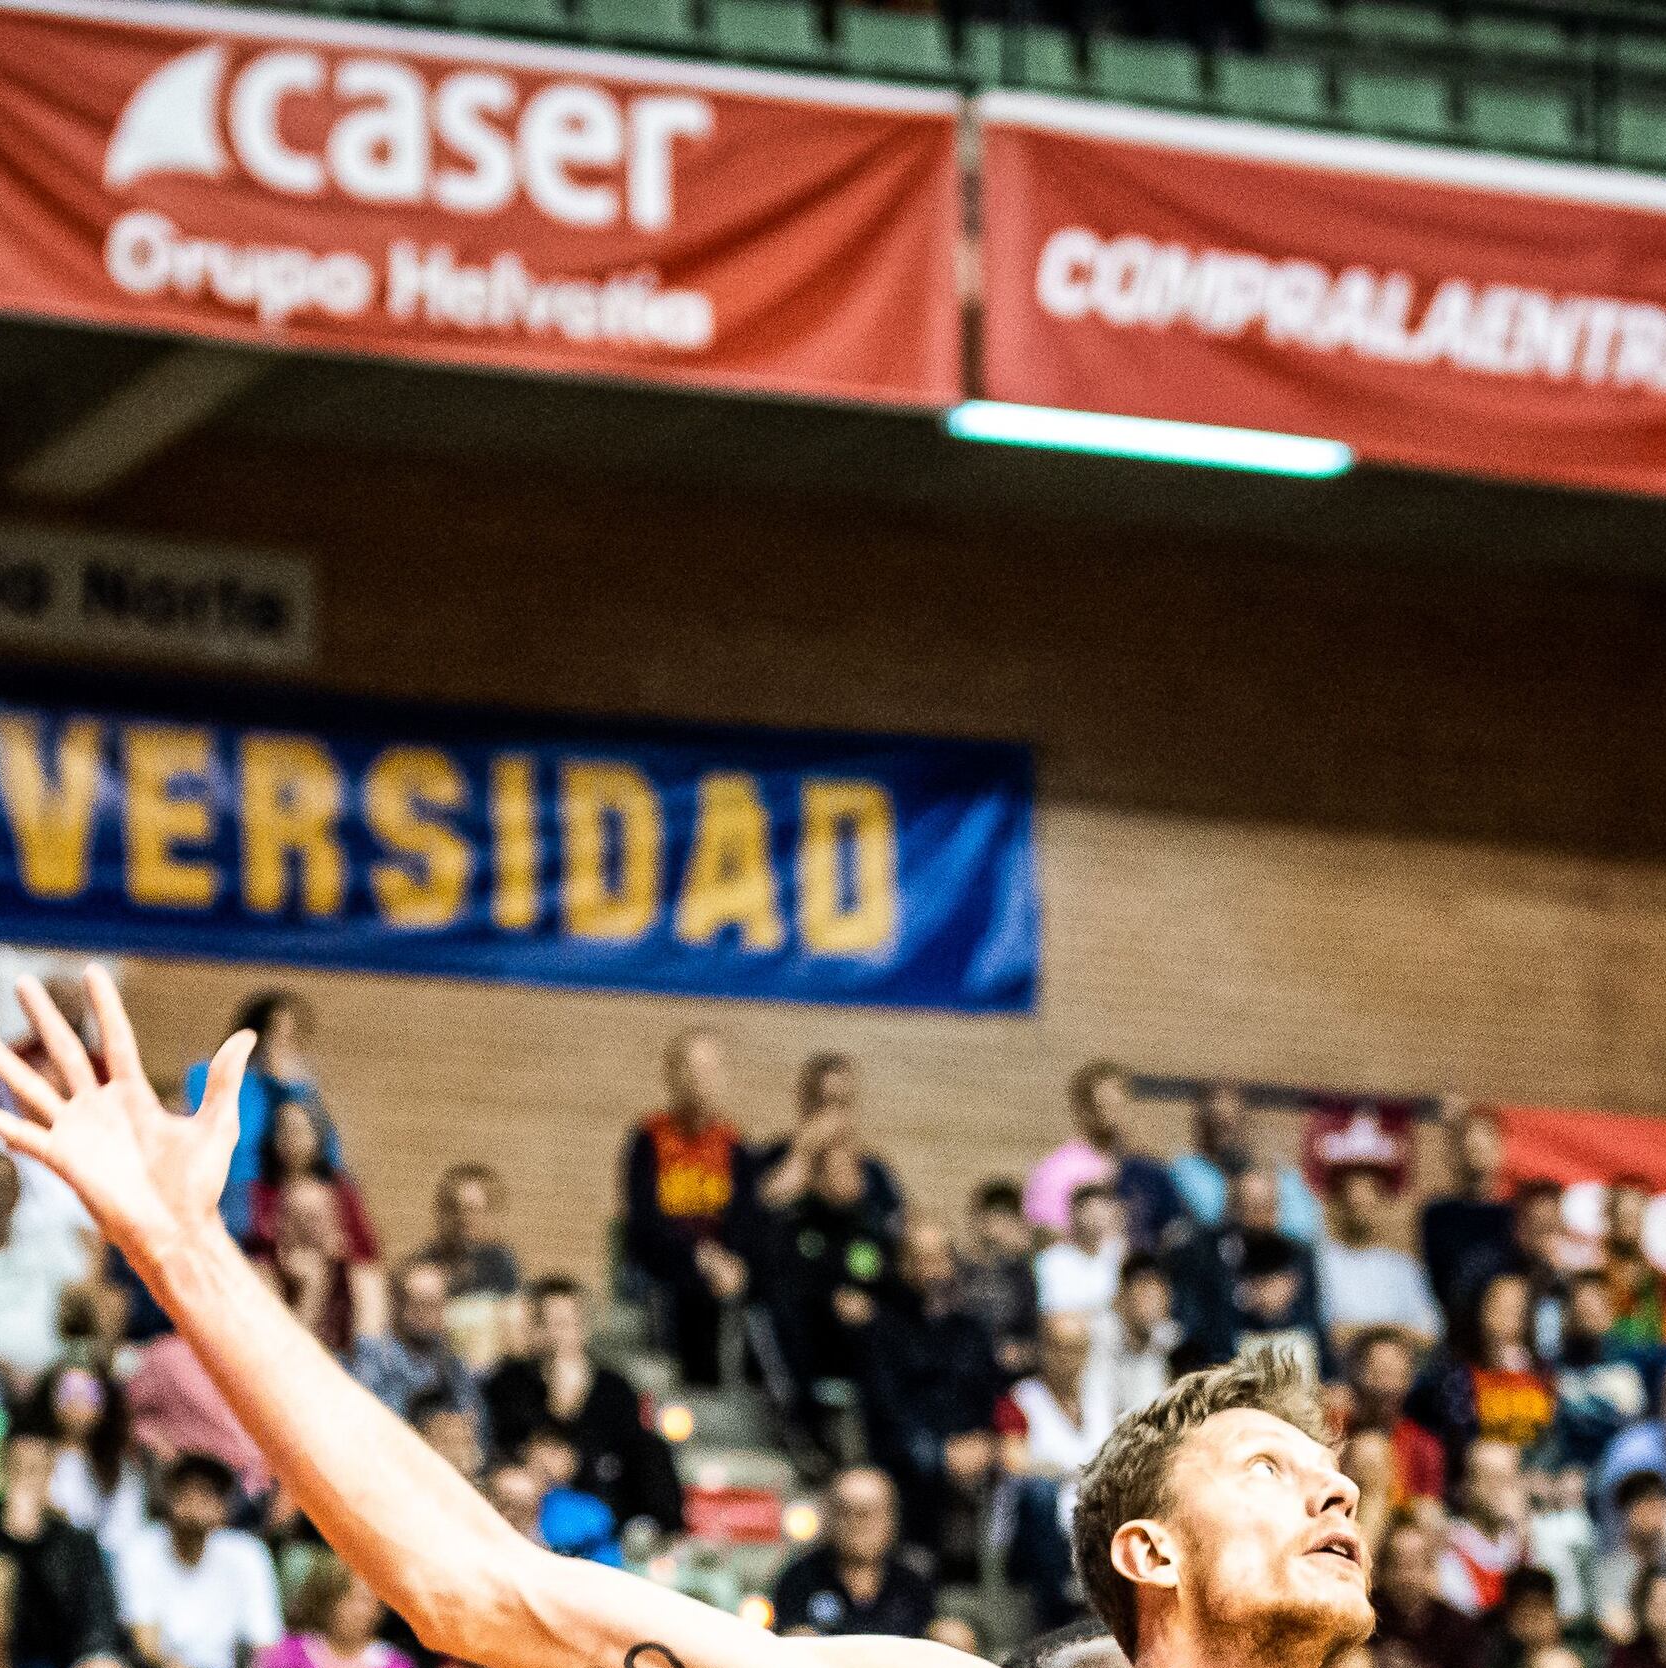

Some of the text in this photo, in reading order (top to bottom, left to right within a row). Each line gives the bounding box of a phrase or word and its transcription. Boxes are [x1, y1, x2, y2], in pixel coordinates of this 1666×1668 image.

[230, 46, 715, 235] caser
[104, 206, 715, 352] Grupo Helvetia
